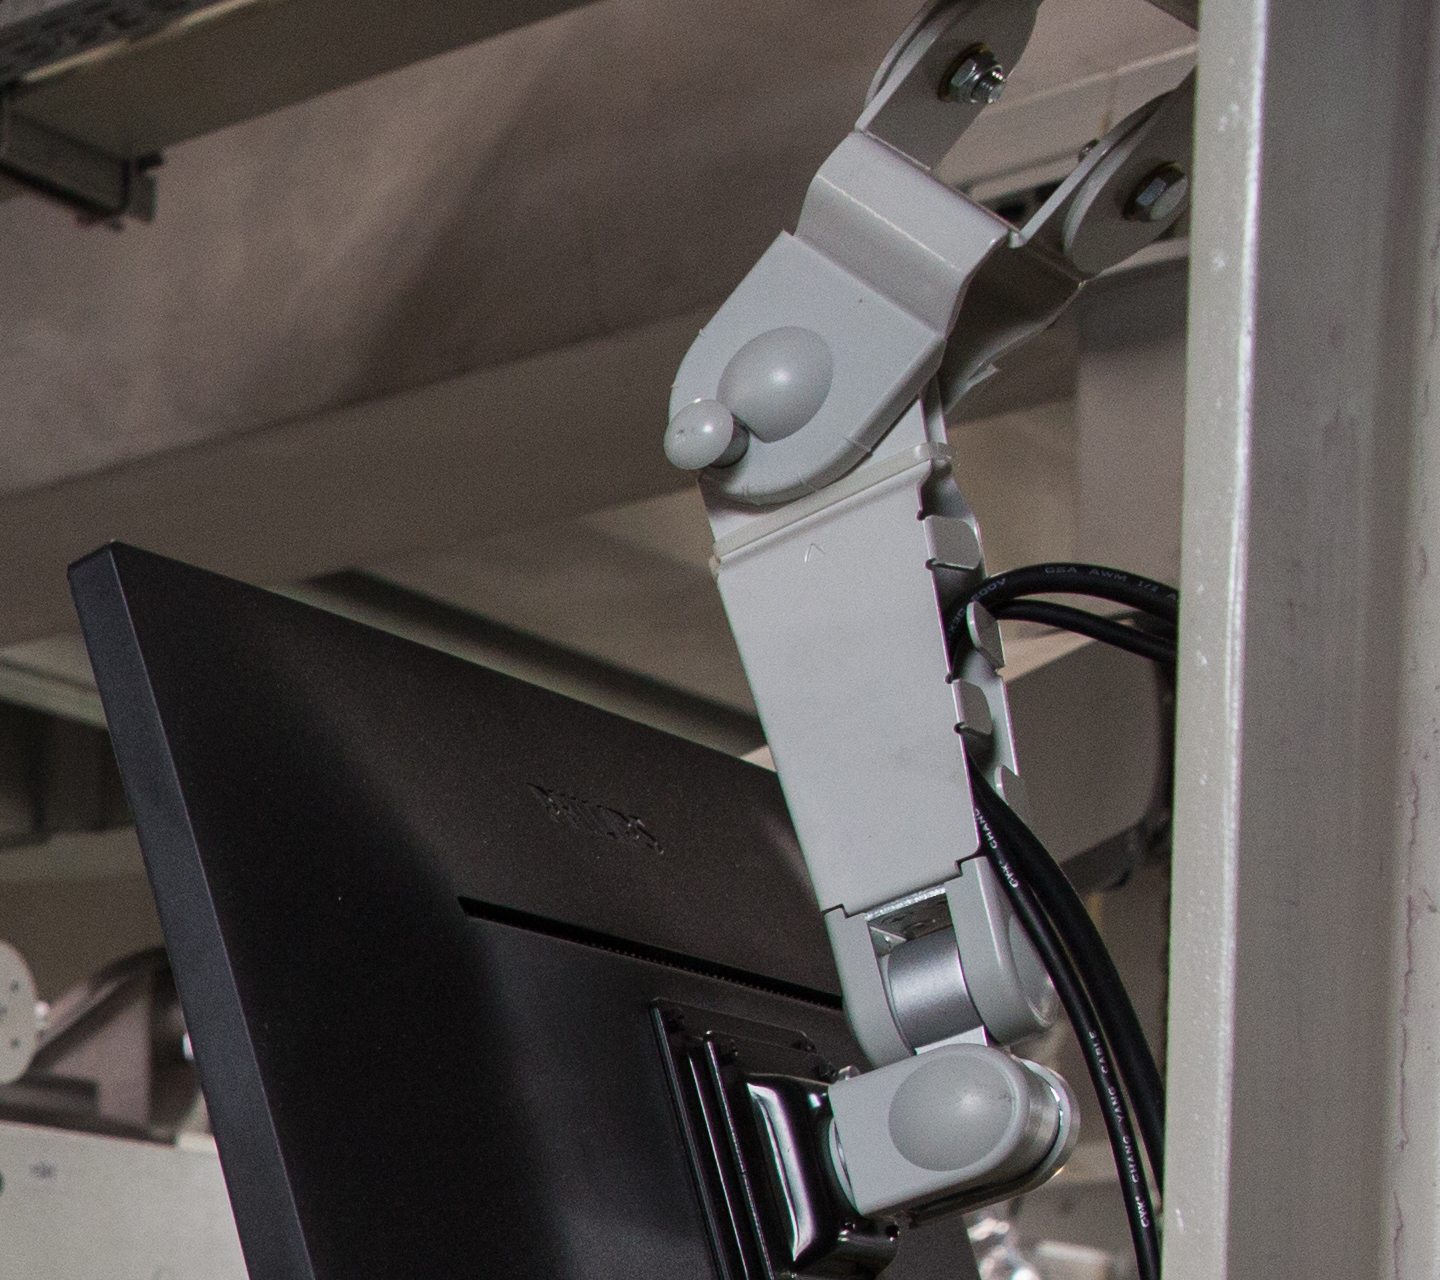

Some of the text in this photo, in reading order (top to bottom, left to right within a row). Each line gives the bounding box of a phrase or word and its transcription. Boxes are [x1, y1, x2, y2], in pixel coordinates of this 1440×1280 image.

[1088, 567, 1128, 582] AWM
[1089, 1030, 1109, 1074] CABLE
[1108, 1086, 1125, 1123] YANG
[1123, 1135, 1140, 1184] CHANG
